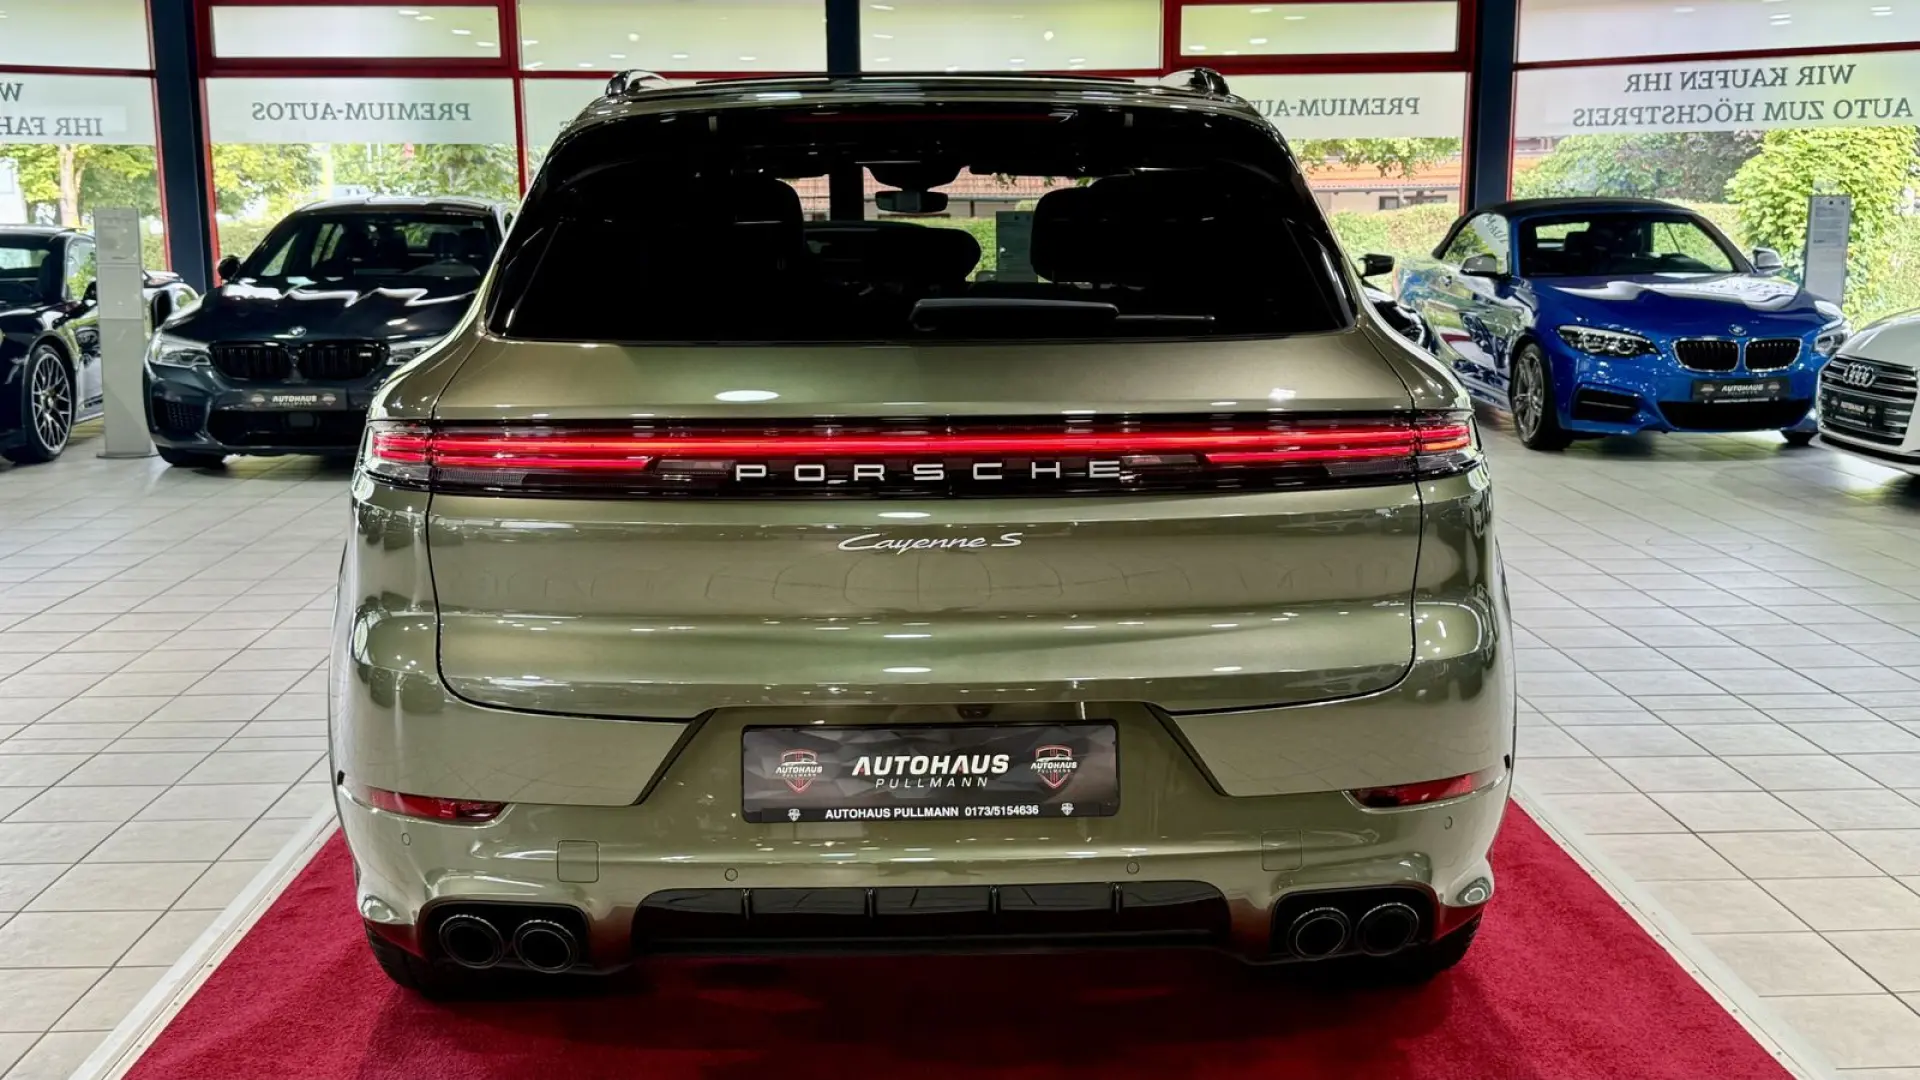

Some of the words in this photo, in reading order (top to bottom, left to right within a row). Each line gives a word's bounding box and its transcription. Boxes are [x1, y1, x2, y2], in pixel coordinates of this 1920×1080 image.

[272, 395, 318, 403] AUTOHAUS
[735, 461, 1120, 482] PORSCHE
[838, 533, 986, 554] Cayenne
[991, 532, 1023, 547] S
[775, 765, 823, 774] AUTOHAUS
[852, 754, 1009, 776] AUTOHAUS
[1030, 761, 1077, 770] AUTOHAUS
[875, 776, 988, 789] PULLMANN
[825, 807, 891, 819] AUTOHAUS
[893, 806, 959, 817] PULLMANN
[964, 804, 1039, 816] 0173/5154636
